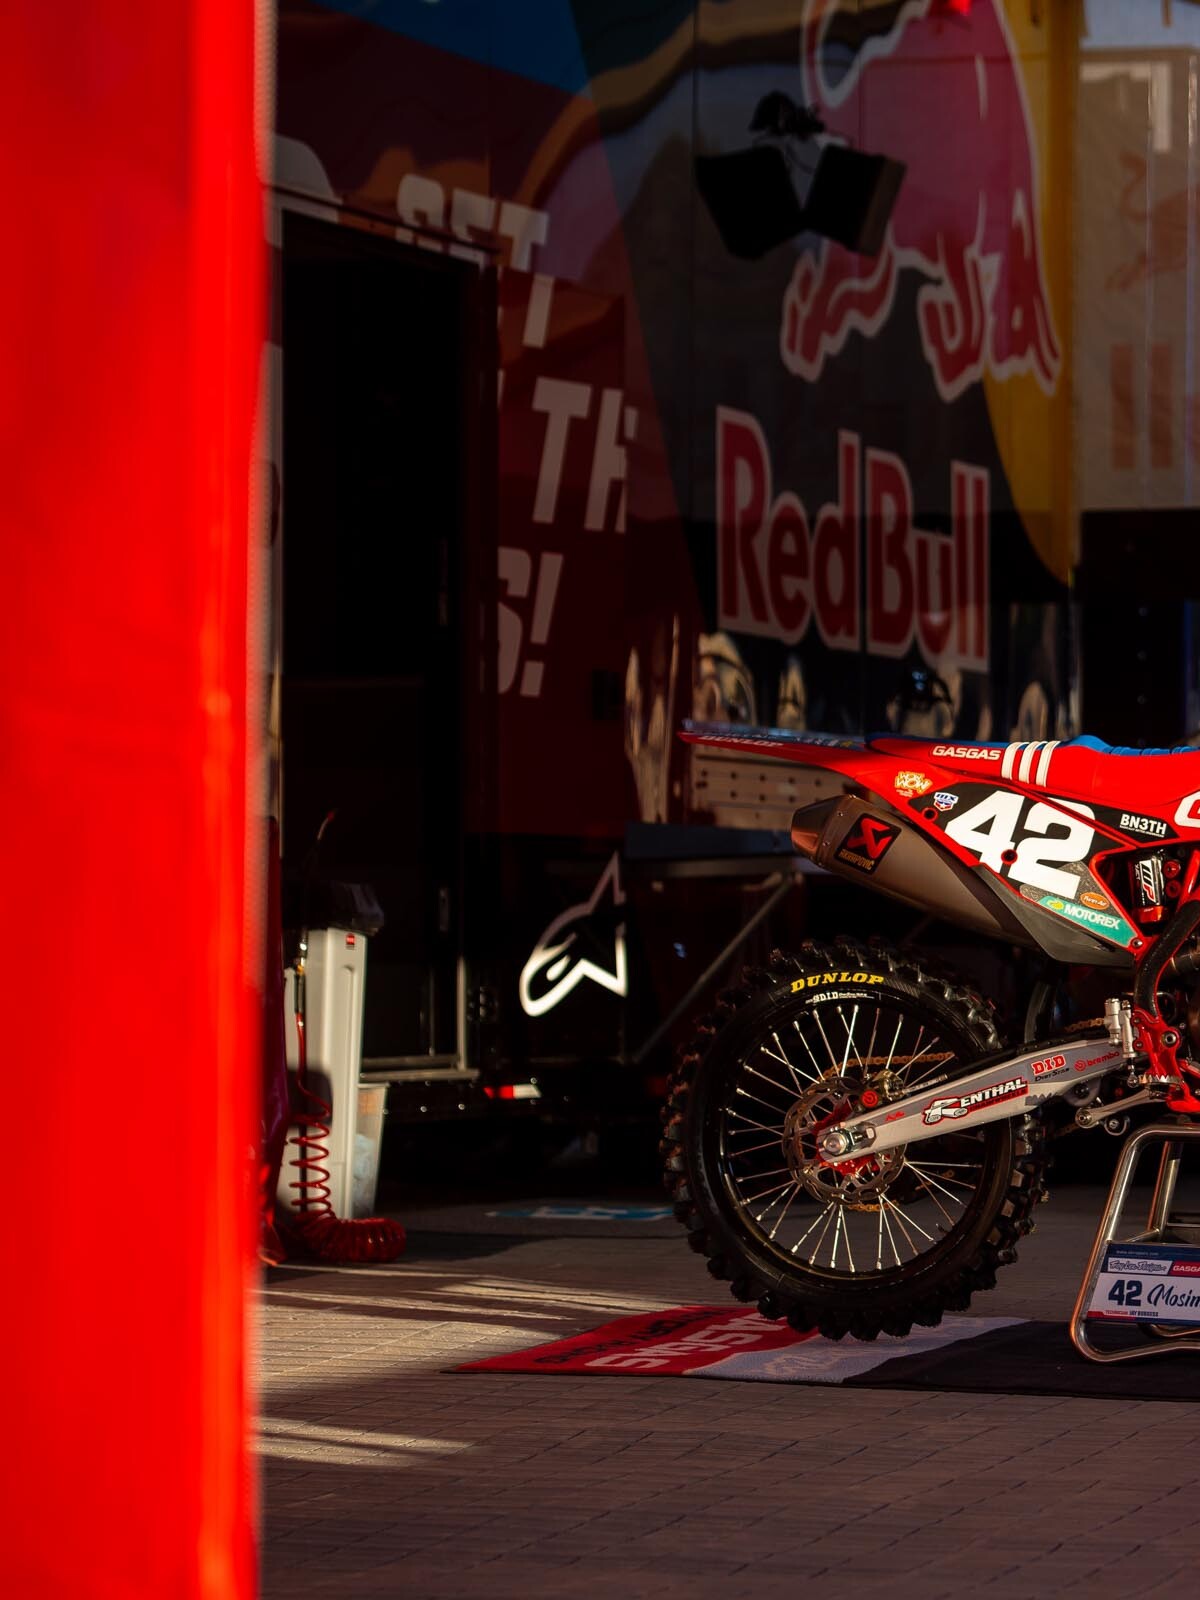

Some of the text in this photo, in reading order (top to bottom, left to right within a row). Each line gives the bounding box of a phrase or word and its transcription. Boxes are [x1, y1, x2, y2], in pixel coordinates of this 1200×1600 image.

[932, 745, 1001, 761] GASGAS
[1120, 813, 1167, 835] BN3TH
[944, 790, 1096, 900] 42
[1063, 903, 1120, 931] MOTOREX
[790, 971, 885, 993] DUNLOP
[1108, 1279, 1143, 1307] 42
